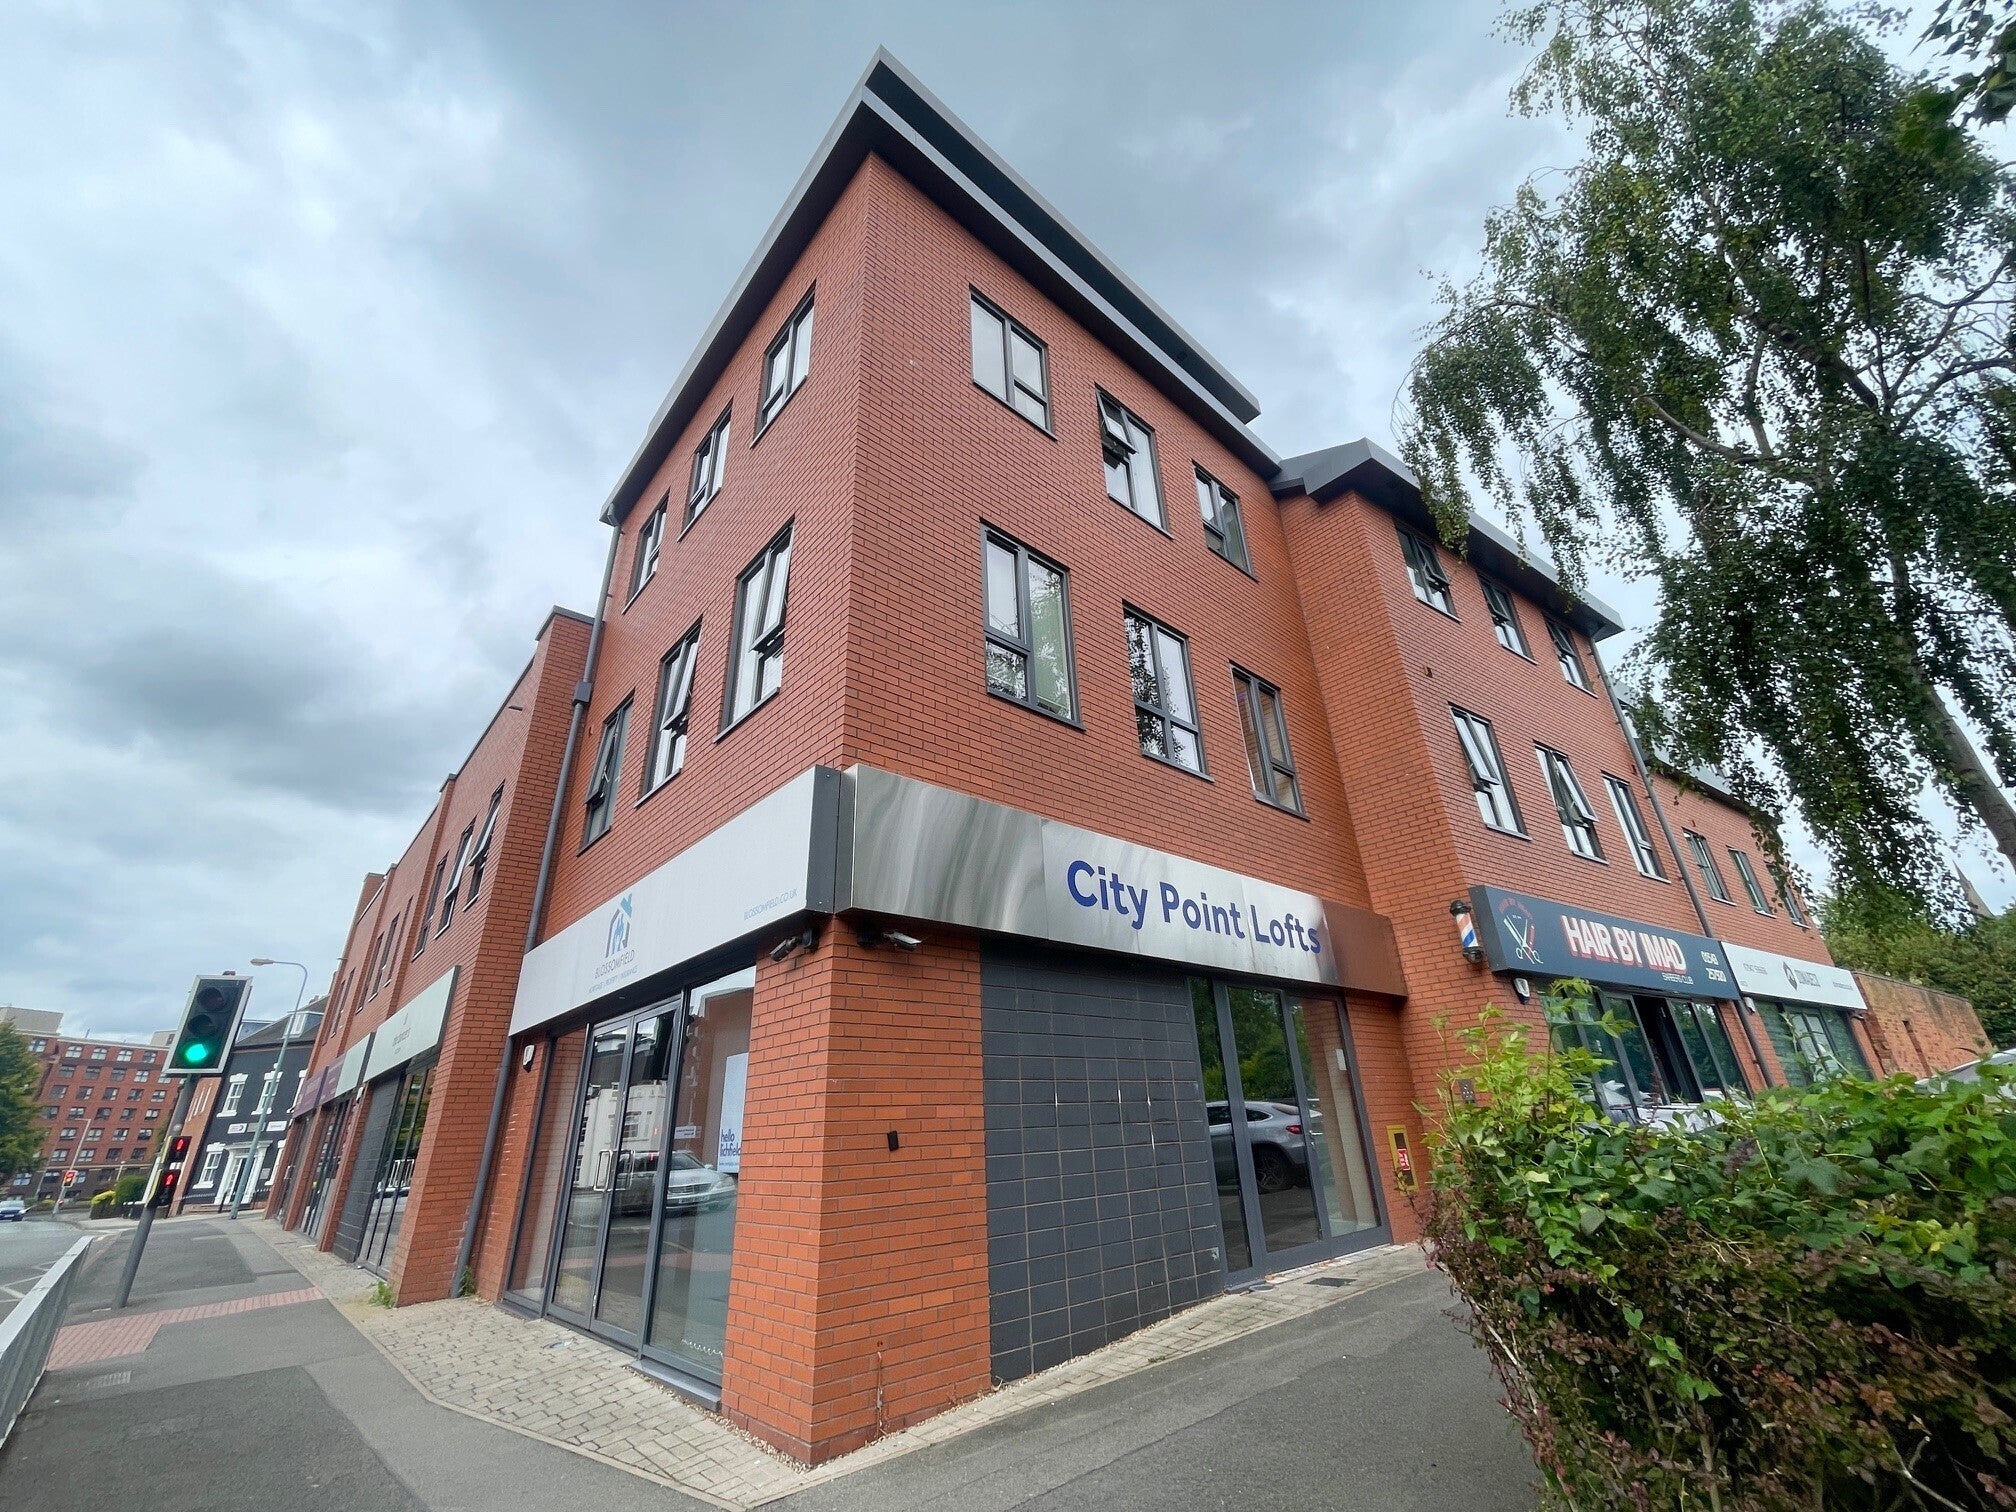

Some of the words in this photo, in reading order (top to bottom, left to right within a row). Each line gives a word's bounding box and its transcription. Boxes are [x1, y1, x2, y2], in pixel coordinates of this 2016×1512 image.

[1067, 860, 1148, 930] City
[1160, 882, 1245, 940] Point
[1250, 905, 1322, 954] Lofts
[594, 949, 636, 979] BLOSSOMFIELD
[1561, 915, 1619, 963] HAIR
[1611, 926, 1643, 967] BY
[1638, 933, 1688, 974] IMAD
[721, 1128, 735, 1142] hello
